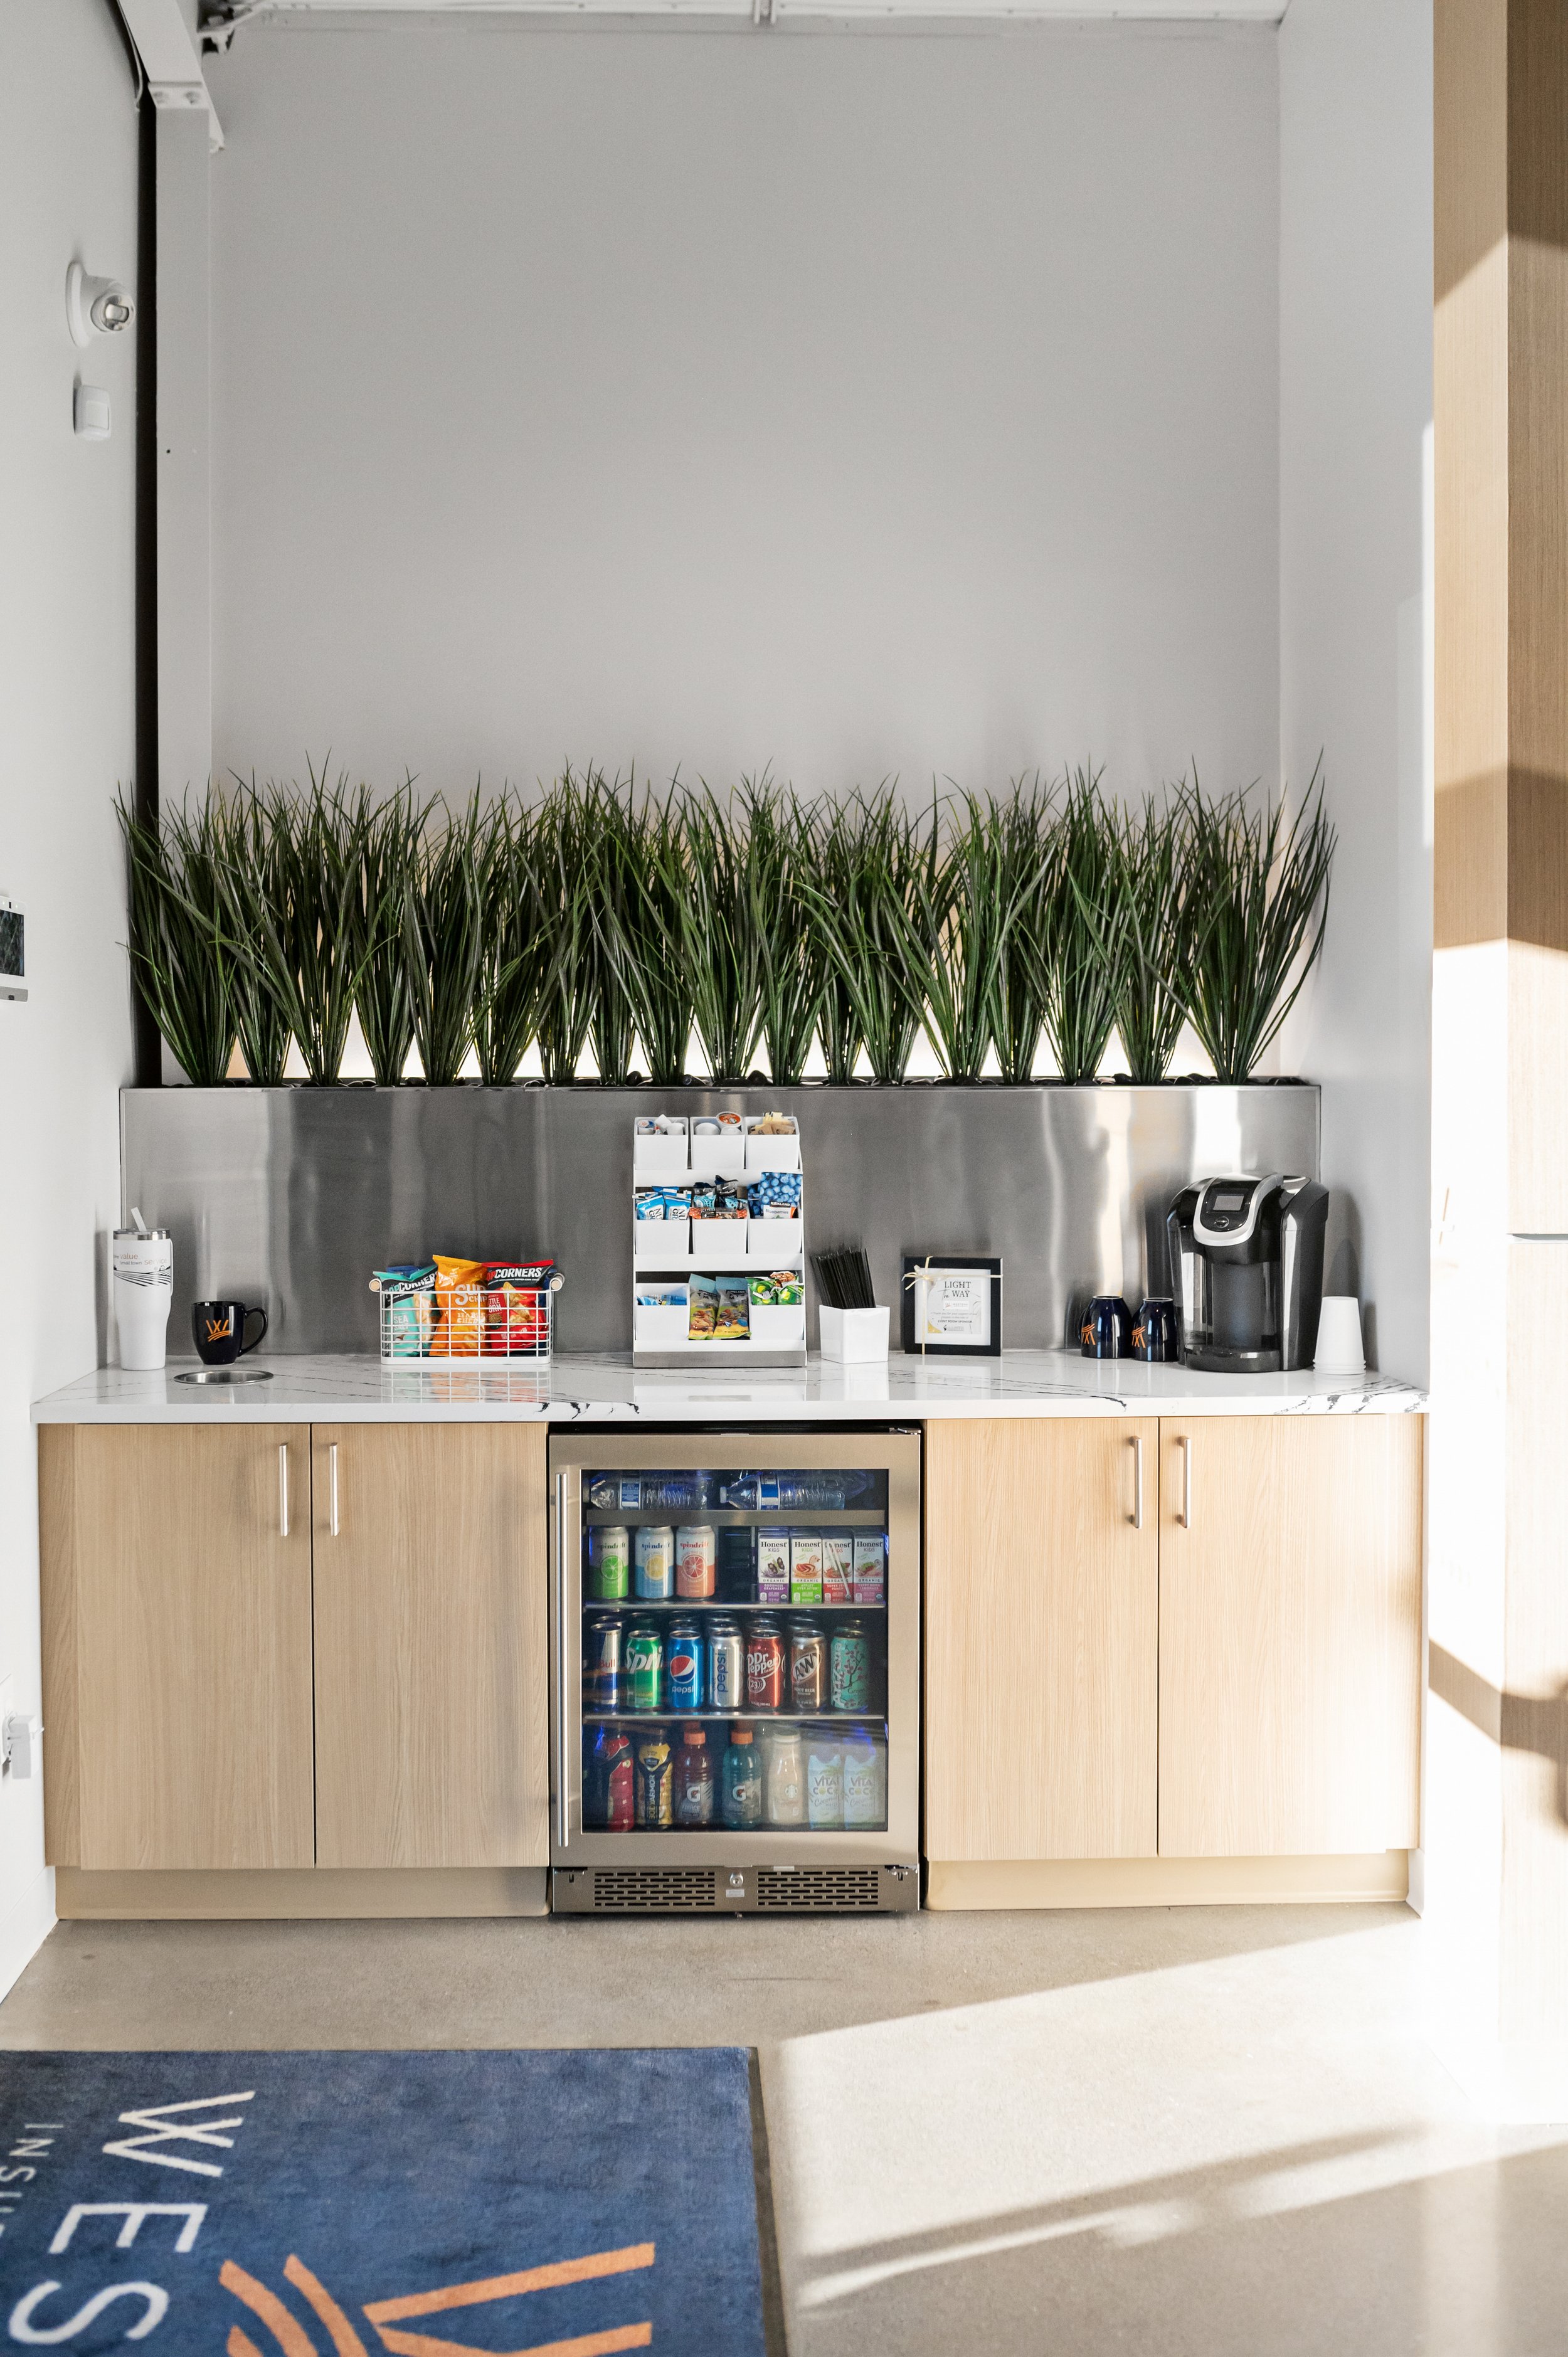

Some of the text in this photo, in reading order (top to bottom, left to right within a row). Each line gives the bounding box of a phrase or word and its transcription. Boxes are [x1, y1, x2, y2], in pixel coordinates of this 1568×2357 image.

[393, 1315, 409, 1323] SEA
[753, 1652, 769, 1665] Dr
[715, 1653, 728, 1692] pepsi
[672, 1685, 694, 1694] pepsi
[813, 1775, 837, 1787] VITA
[850, 1776, 874, 1787] VITA
[9, 2090, 255, 2343] WES
